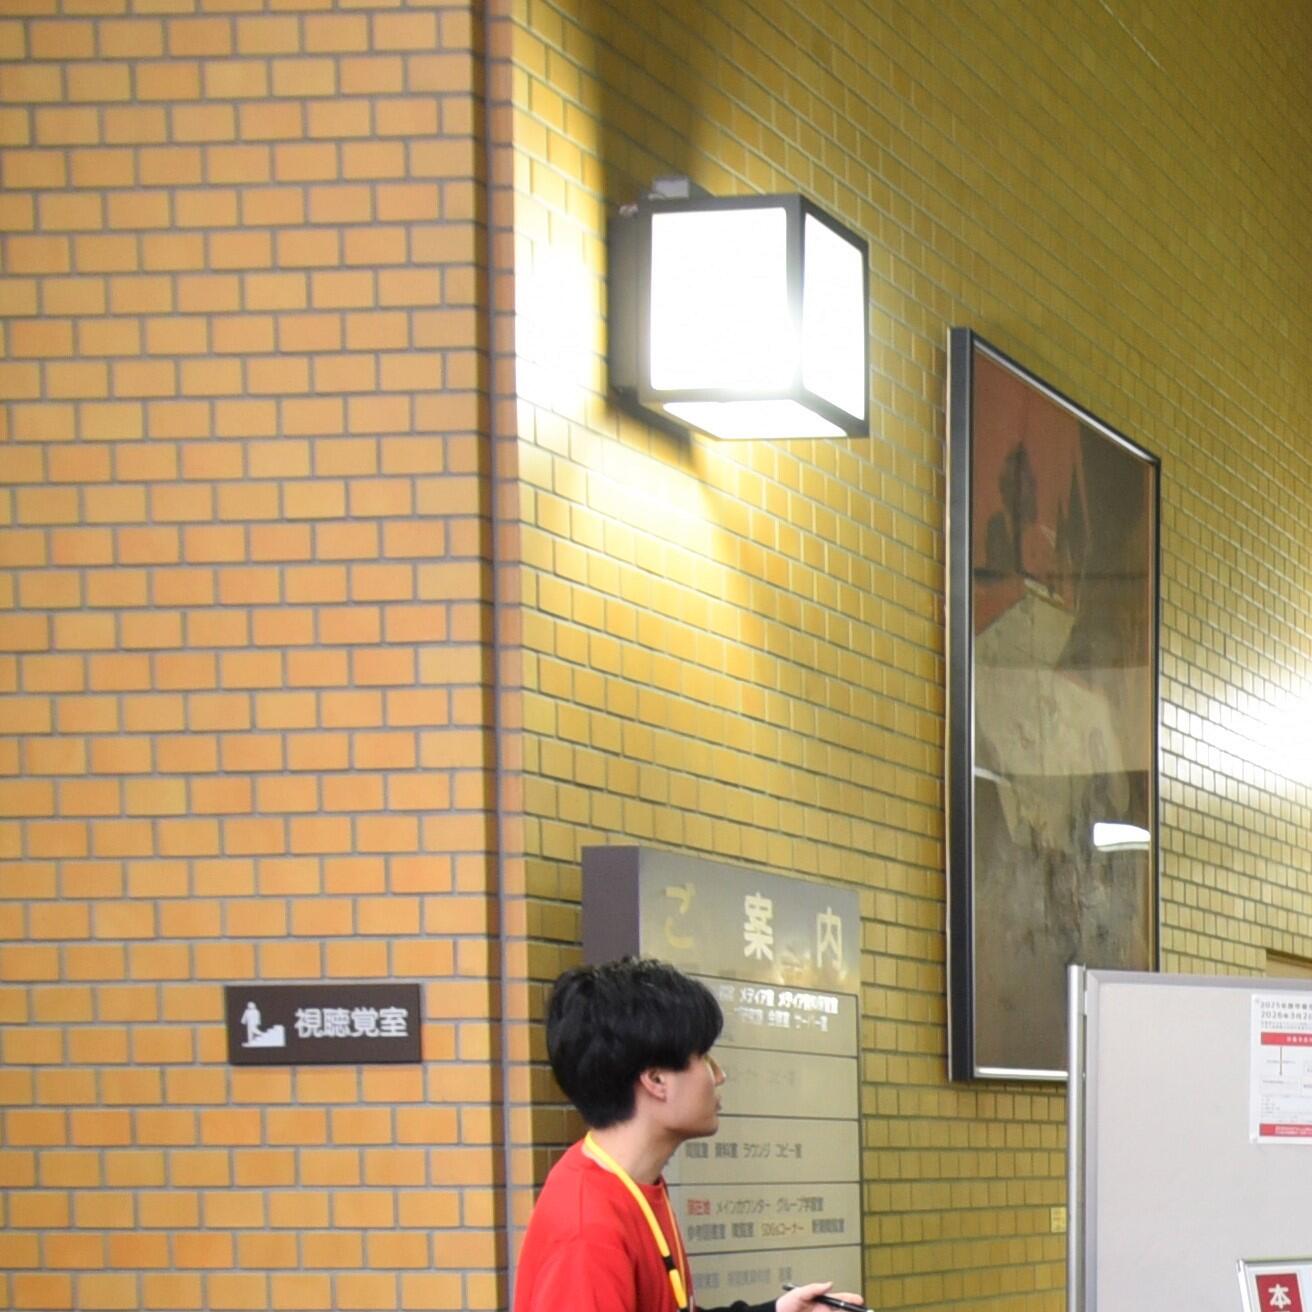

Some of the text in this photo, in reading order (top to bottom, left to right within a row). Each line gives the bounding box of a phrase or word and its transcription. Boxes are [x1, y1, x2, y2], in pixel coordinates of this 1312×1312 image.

[665, 883, 844, 970] ご案内
[294, 1007, 409, 1039] 視聴覚室
